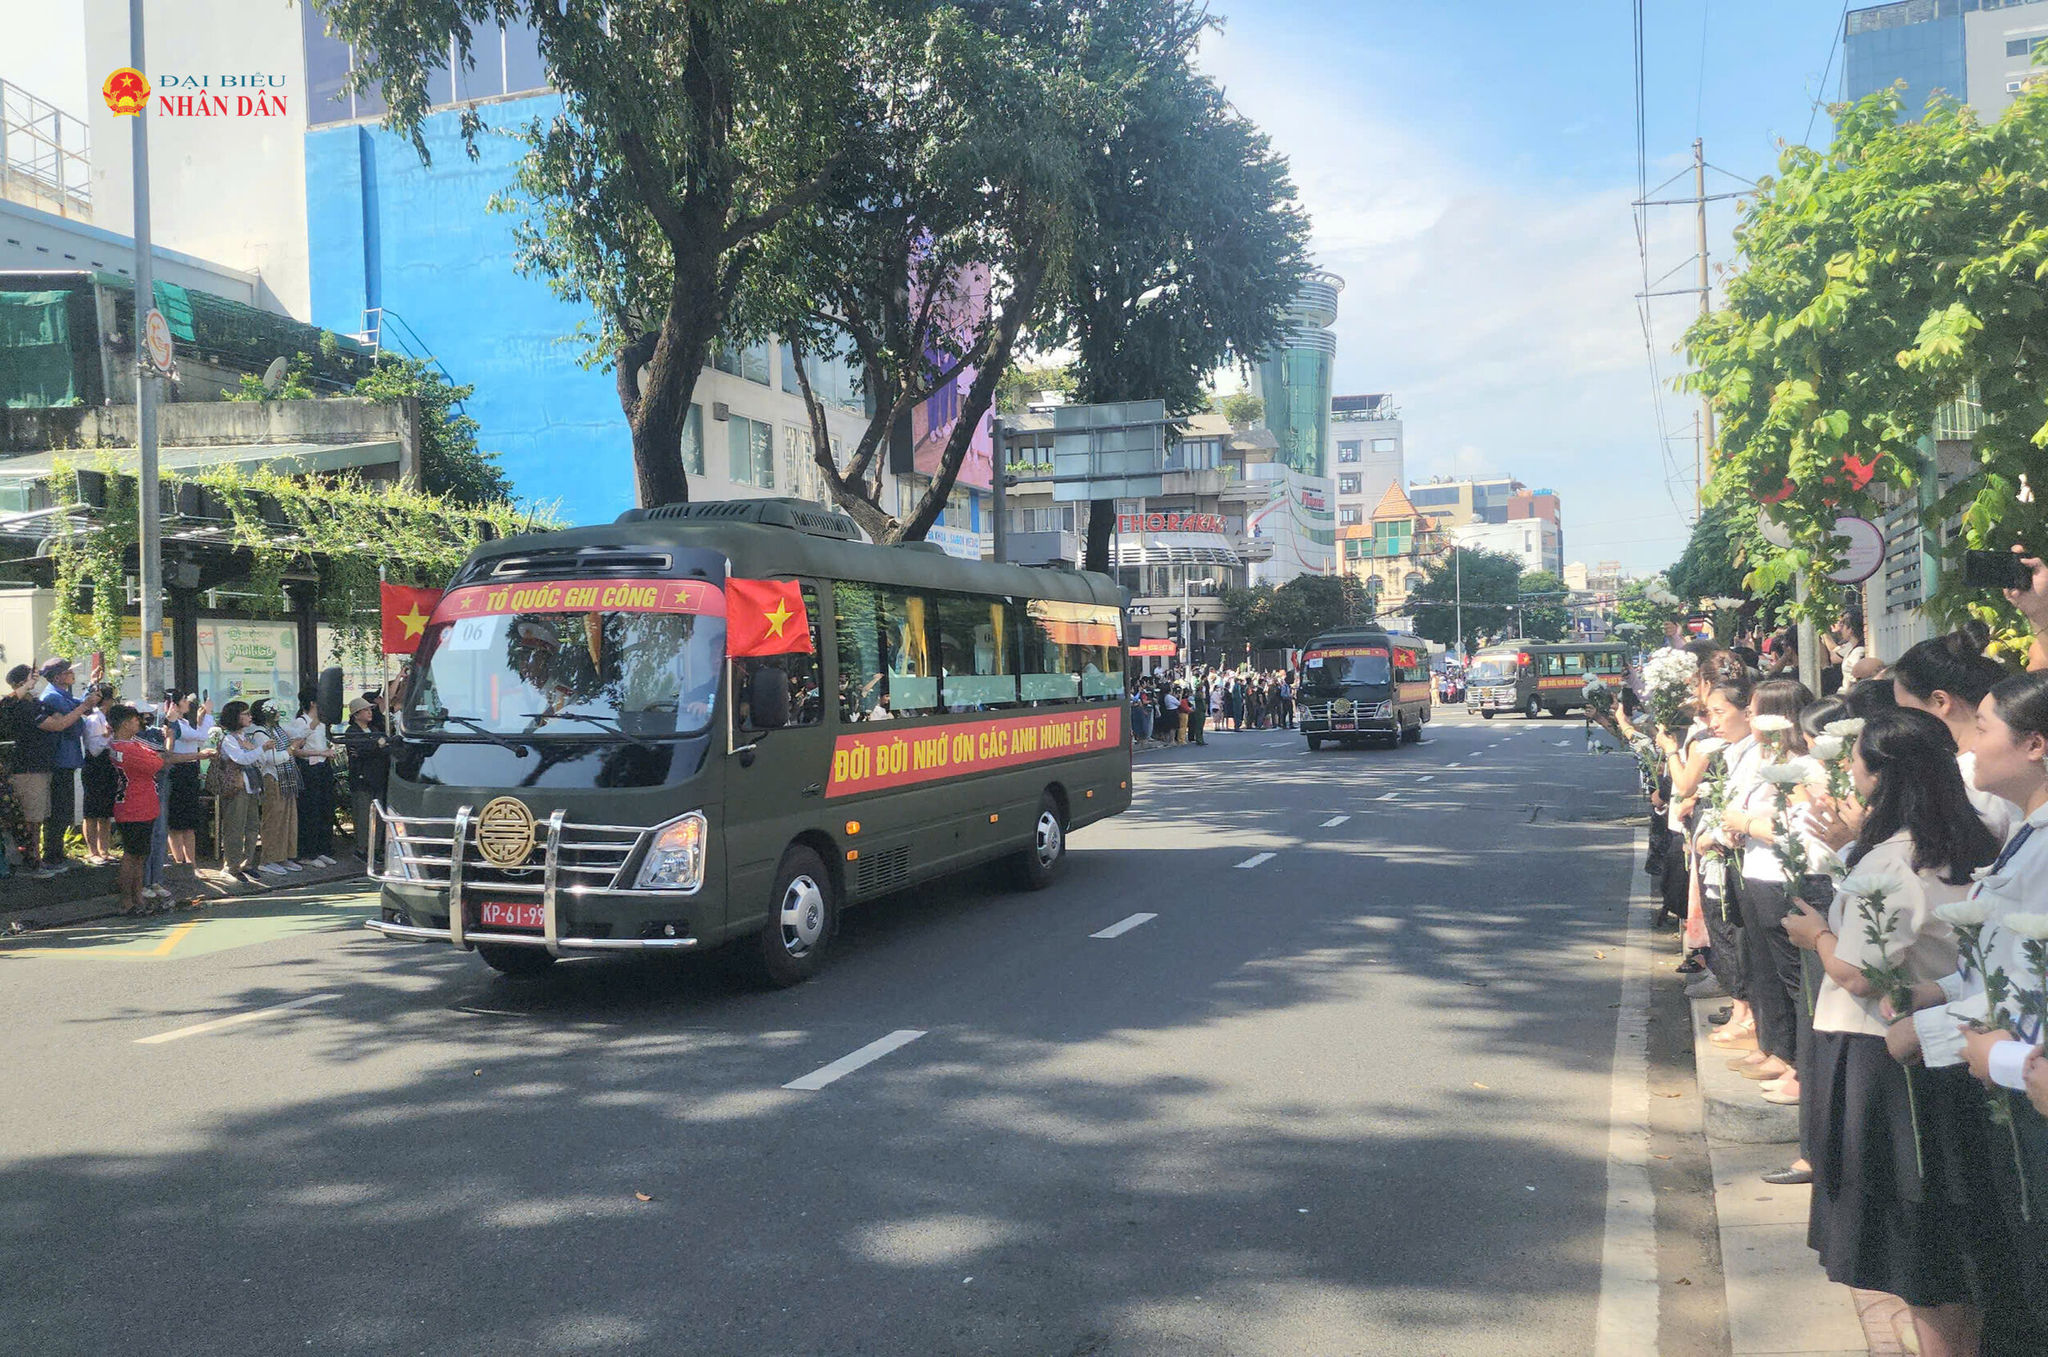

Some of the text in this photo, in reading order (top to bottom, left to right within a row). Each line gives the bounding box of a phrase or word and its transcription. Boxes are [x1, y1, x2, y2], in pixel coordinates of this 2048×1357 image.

[486, 582, 658, 611] TỔ QUỐC GHI CÔNG
[463, 621, 484, 641] 06
[834, 713, 1107, 783] ĐỜI ĐỜI NHỚ ƠN CÁC ANH HÙNG LIỆT SĨ
[483, 902, 545, 925] KP-61-99
